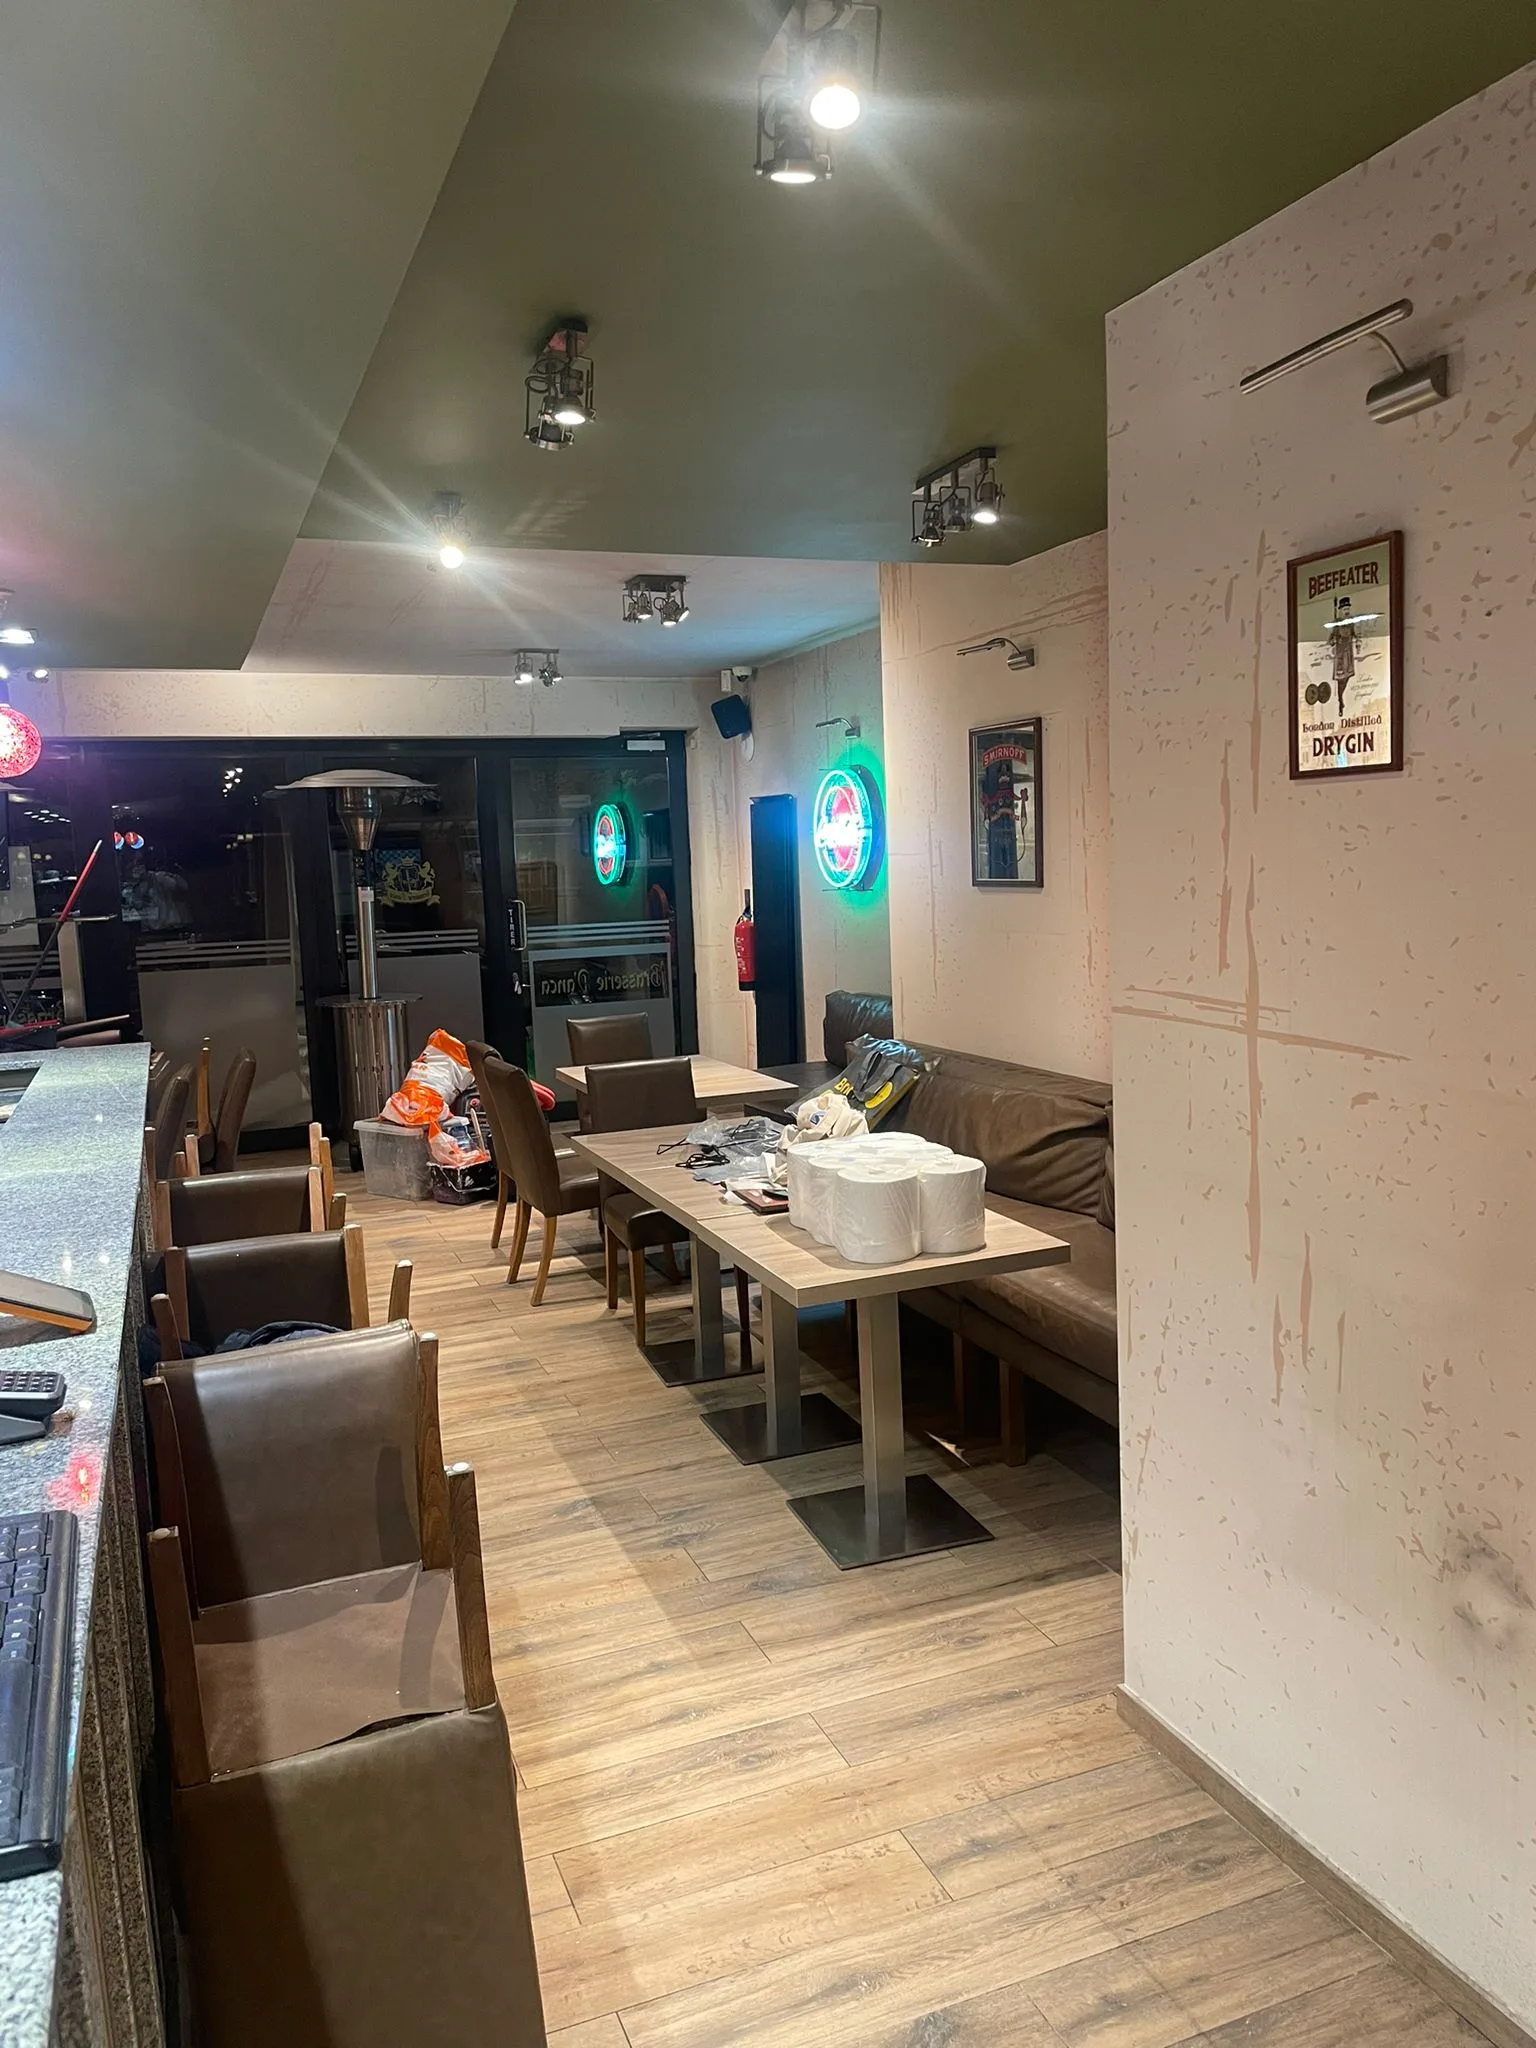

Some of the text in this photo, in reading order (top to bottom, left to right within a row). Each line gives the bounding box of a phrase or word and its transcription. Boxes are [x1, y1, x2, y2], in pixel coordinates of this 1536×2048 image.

[1308, 561, 1379, 600] BEEFEATER
[1341, 715, 1382, 728] Distilled
[983, 746, 1025, 766] SMIRNOFF
